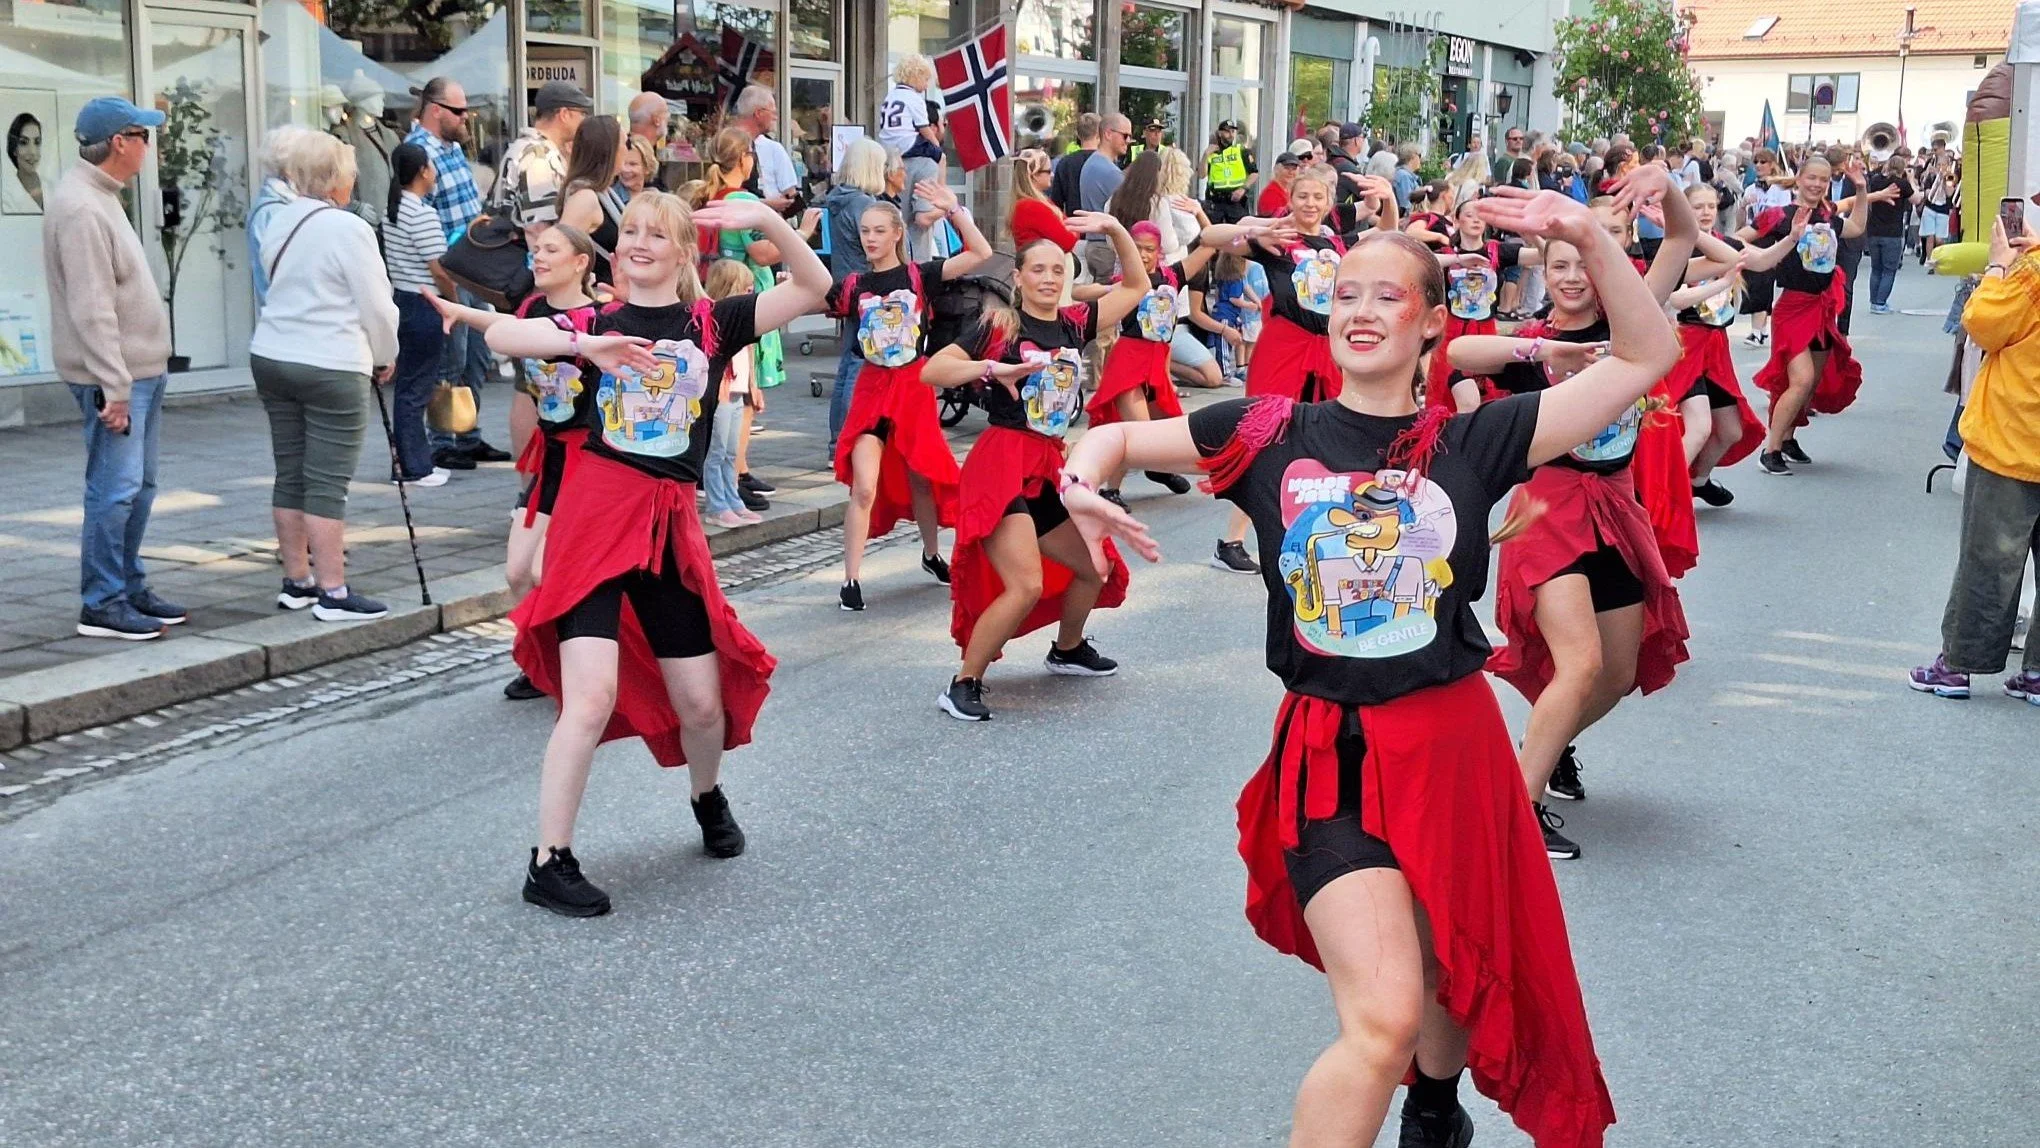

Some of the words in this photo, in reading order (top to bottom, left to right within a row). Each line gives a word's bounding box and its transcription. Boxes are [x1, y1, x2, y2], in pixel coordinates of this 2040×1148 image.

[1450, 36, 1473, 63] EGON
[1358, 637, 1377, 653] BE
[1377, 622, 1430, 646] GENTLE
